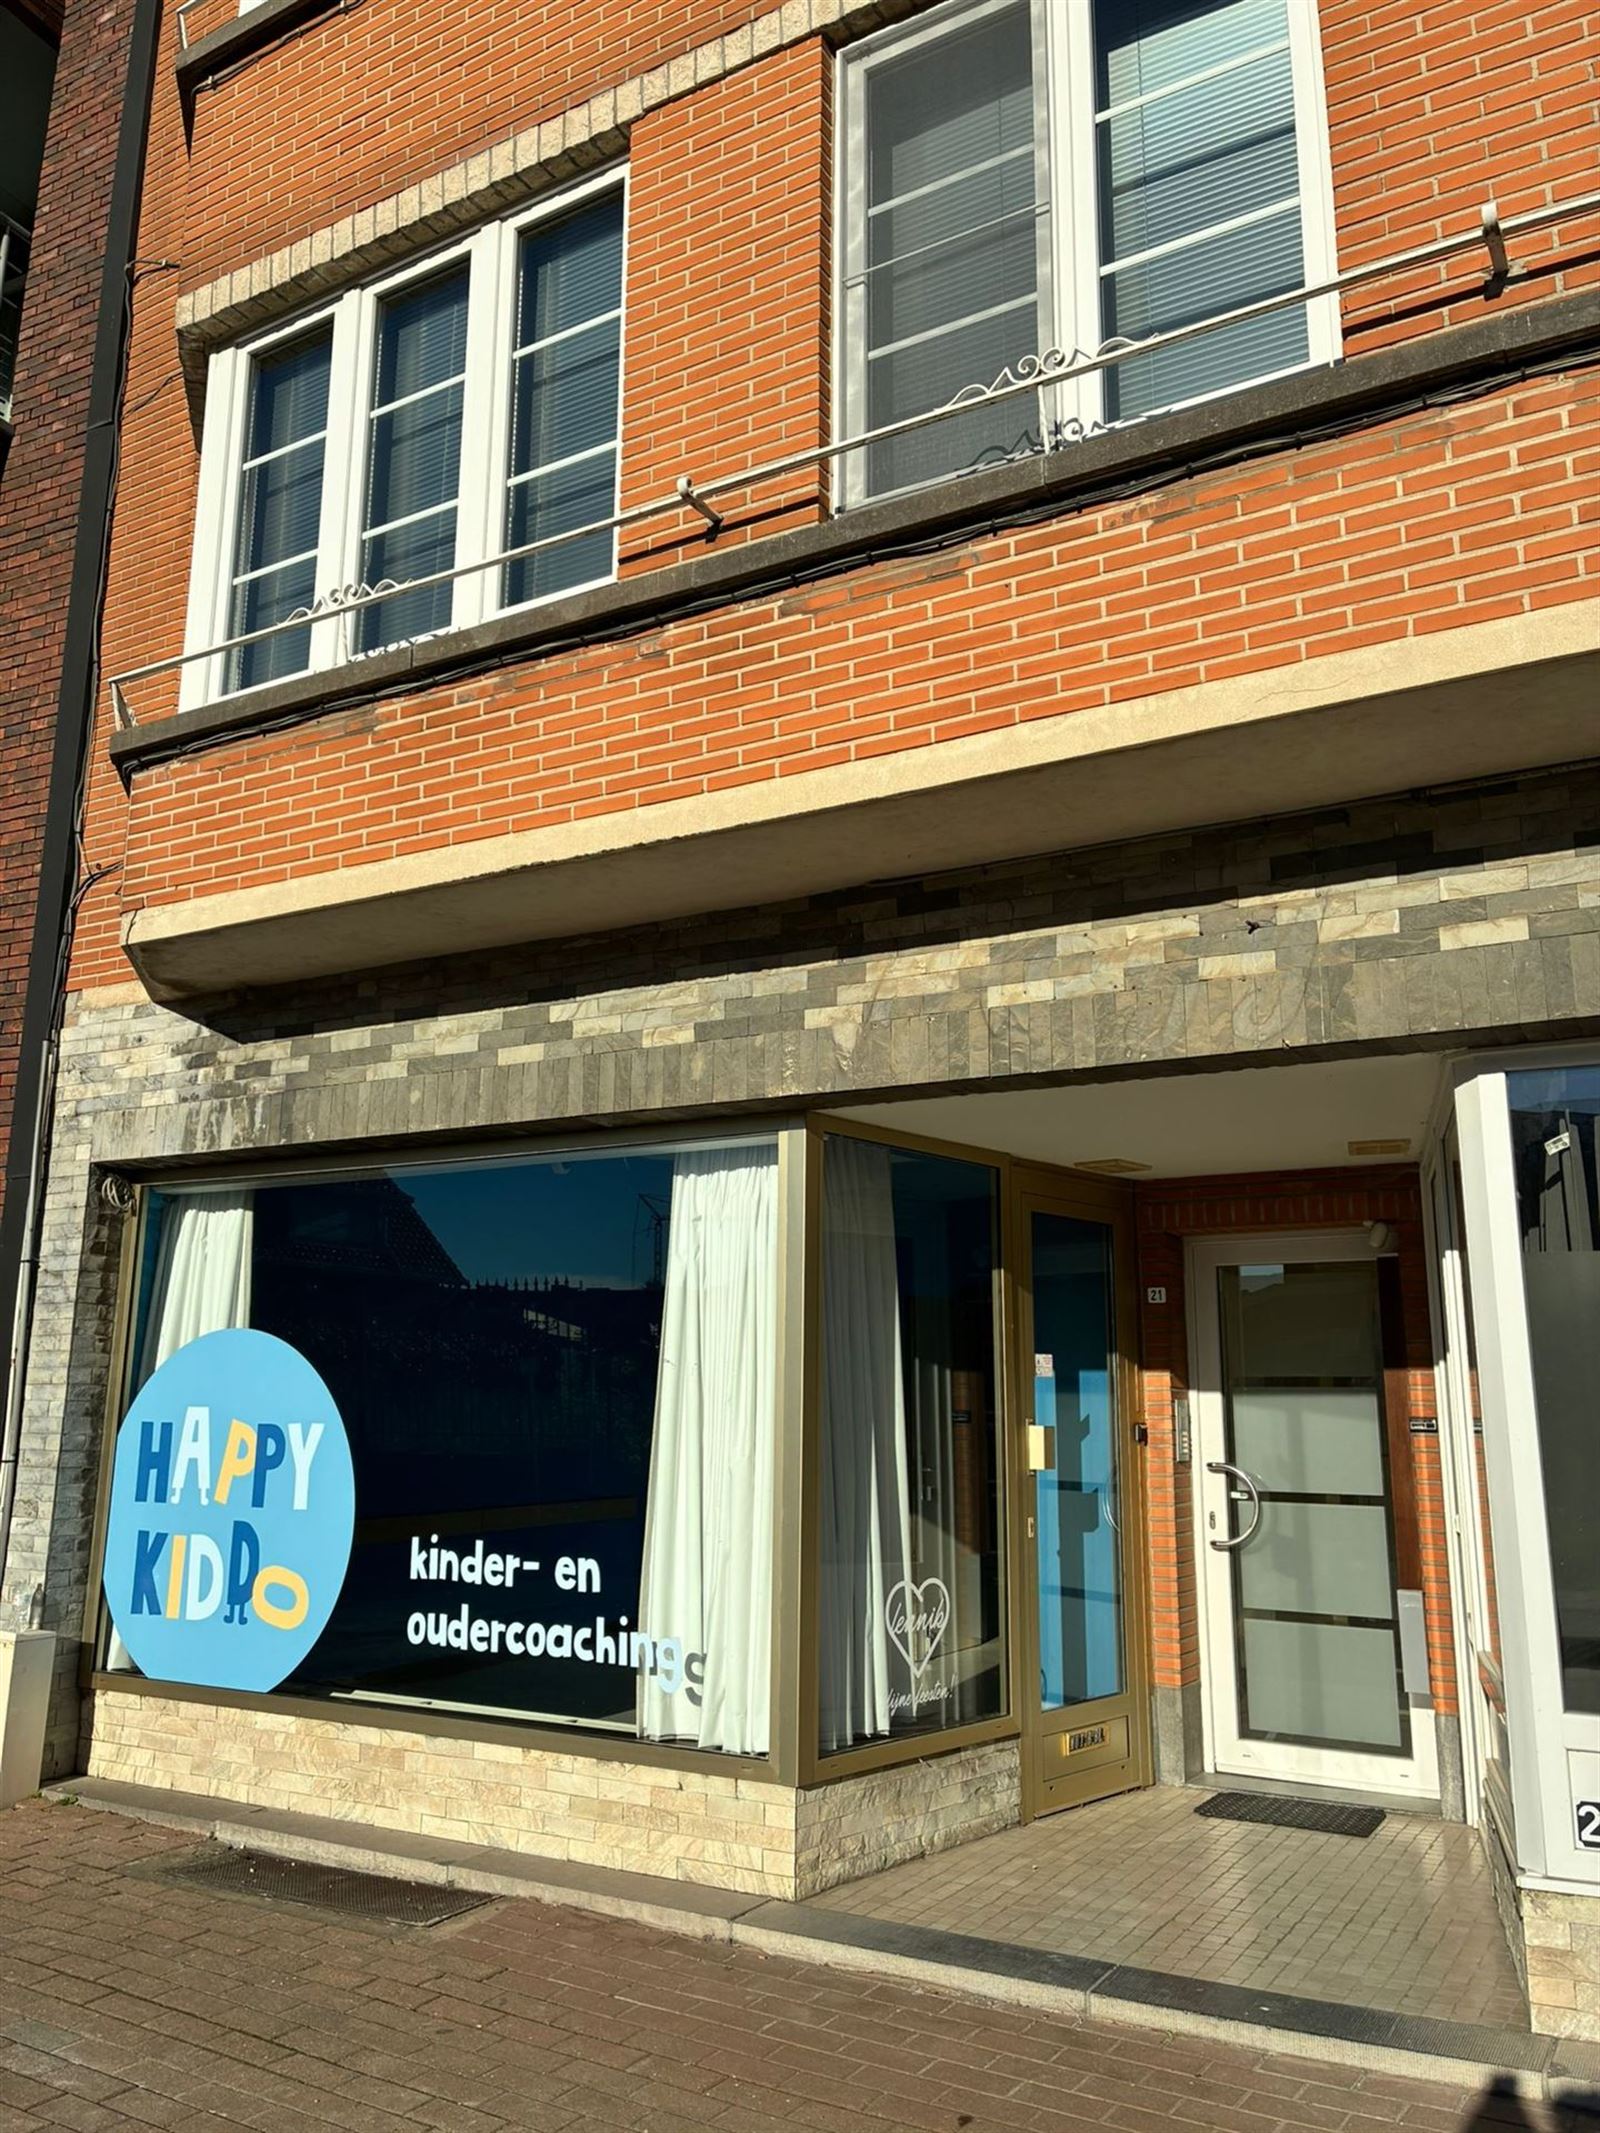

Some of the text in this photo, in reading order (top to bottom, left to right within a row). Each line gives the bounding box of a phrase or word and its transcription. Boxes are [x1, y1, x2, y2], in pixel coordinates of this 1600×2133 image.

[1151, 1289, 1163, 1301] 21
[135, 1406, 325, 1510] HAPPY
[131, 1520, 309, 1630] KIDDO
[410, 1534, 600, 1593] kinder- en
[407, 1603, 682, 1694] oudercoaching
